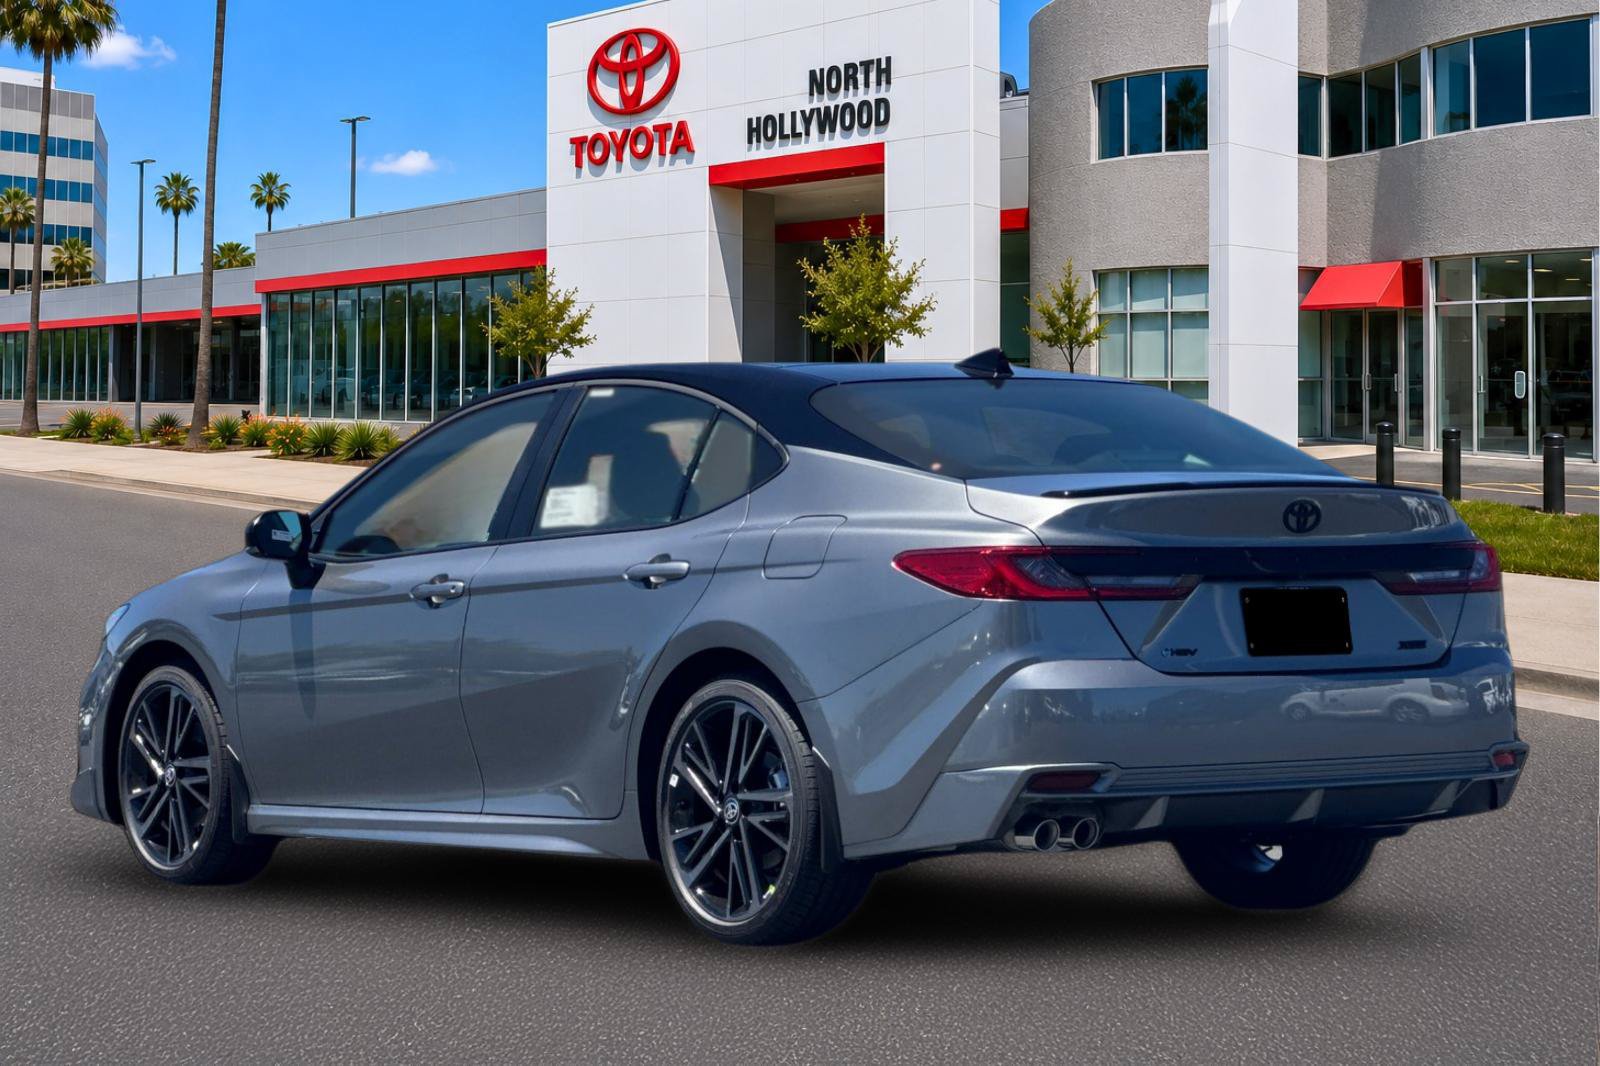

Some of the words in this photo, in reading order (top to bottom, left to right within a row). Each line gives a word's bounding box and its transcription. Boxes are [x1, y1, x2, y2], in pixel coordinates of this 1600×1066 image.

[809, 56, 892, 97] NORTH
[569, 120, 695, 169] TOYOTA
[747, 97, 891, 145] HOLLYWOOD
